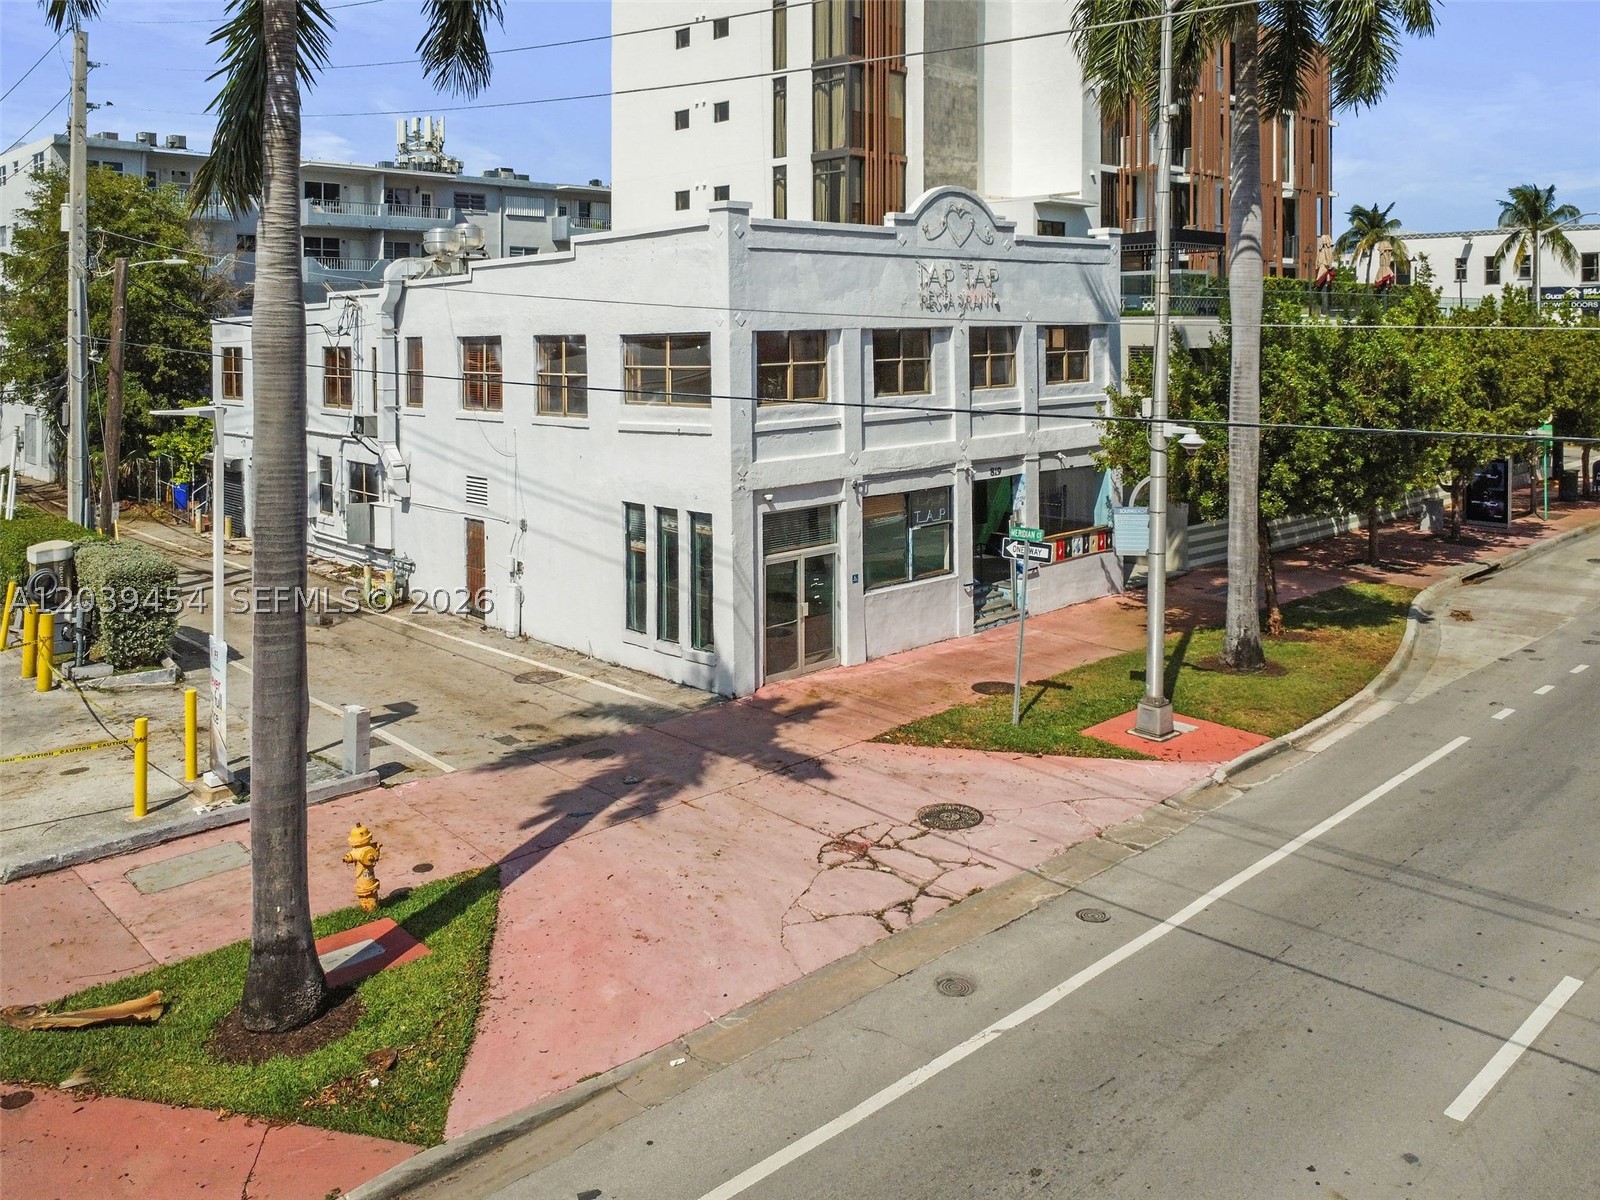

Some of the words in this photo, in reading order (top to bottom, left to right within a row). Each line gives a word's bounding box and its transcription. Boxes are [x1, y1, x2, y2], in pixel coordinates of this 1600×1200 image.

[960, 261, 1000, 290] TAP
[989, 467, 1002, 477] 819
[913, 507, 946, 523] TAP
[1010, 528, 1036, 539] MERIDIAN
[1012, 544, 1025, 554] ONE
[1029, 547, 1042, 557] WAY
[21, 751, 55, 761] CAUTION
[59, 745, 92, 754] CAUTION
[97, 739, 129, 749] CAUTION
